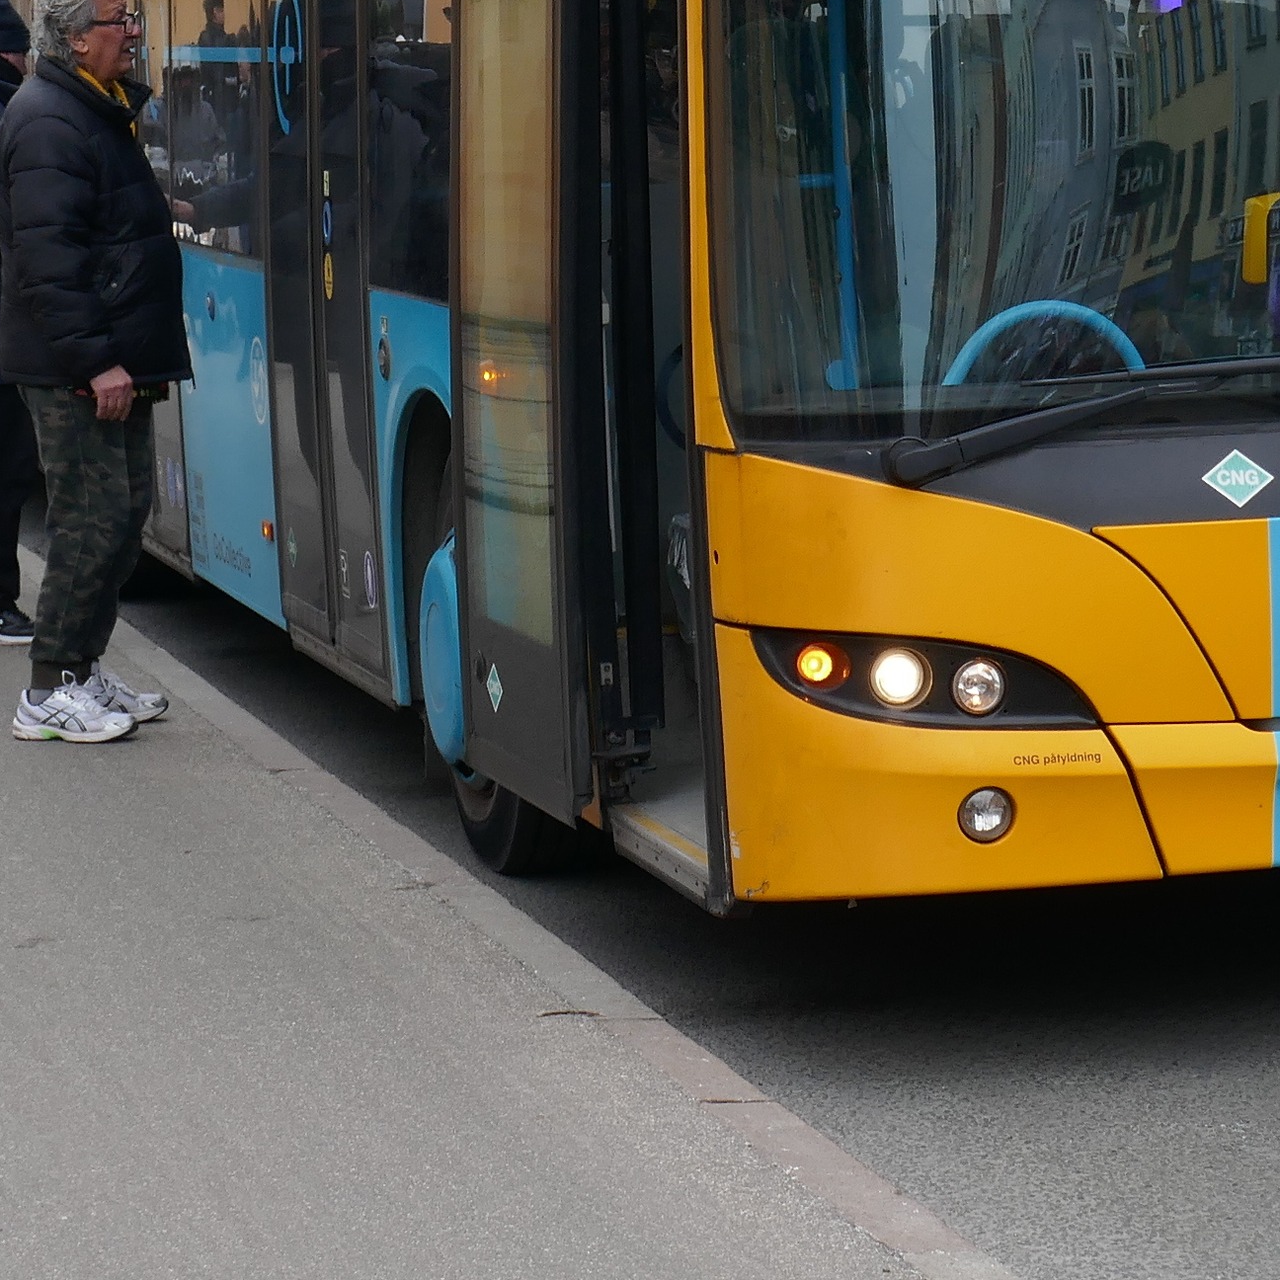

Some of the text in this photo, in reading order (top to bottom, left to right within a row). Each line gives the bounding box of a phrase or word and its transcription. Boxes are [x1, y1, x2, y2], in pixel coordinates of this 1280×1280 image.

[1217, 469, 1260, 486] CNG
[1013, 751, 1102, 766] CNG påfyldning
